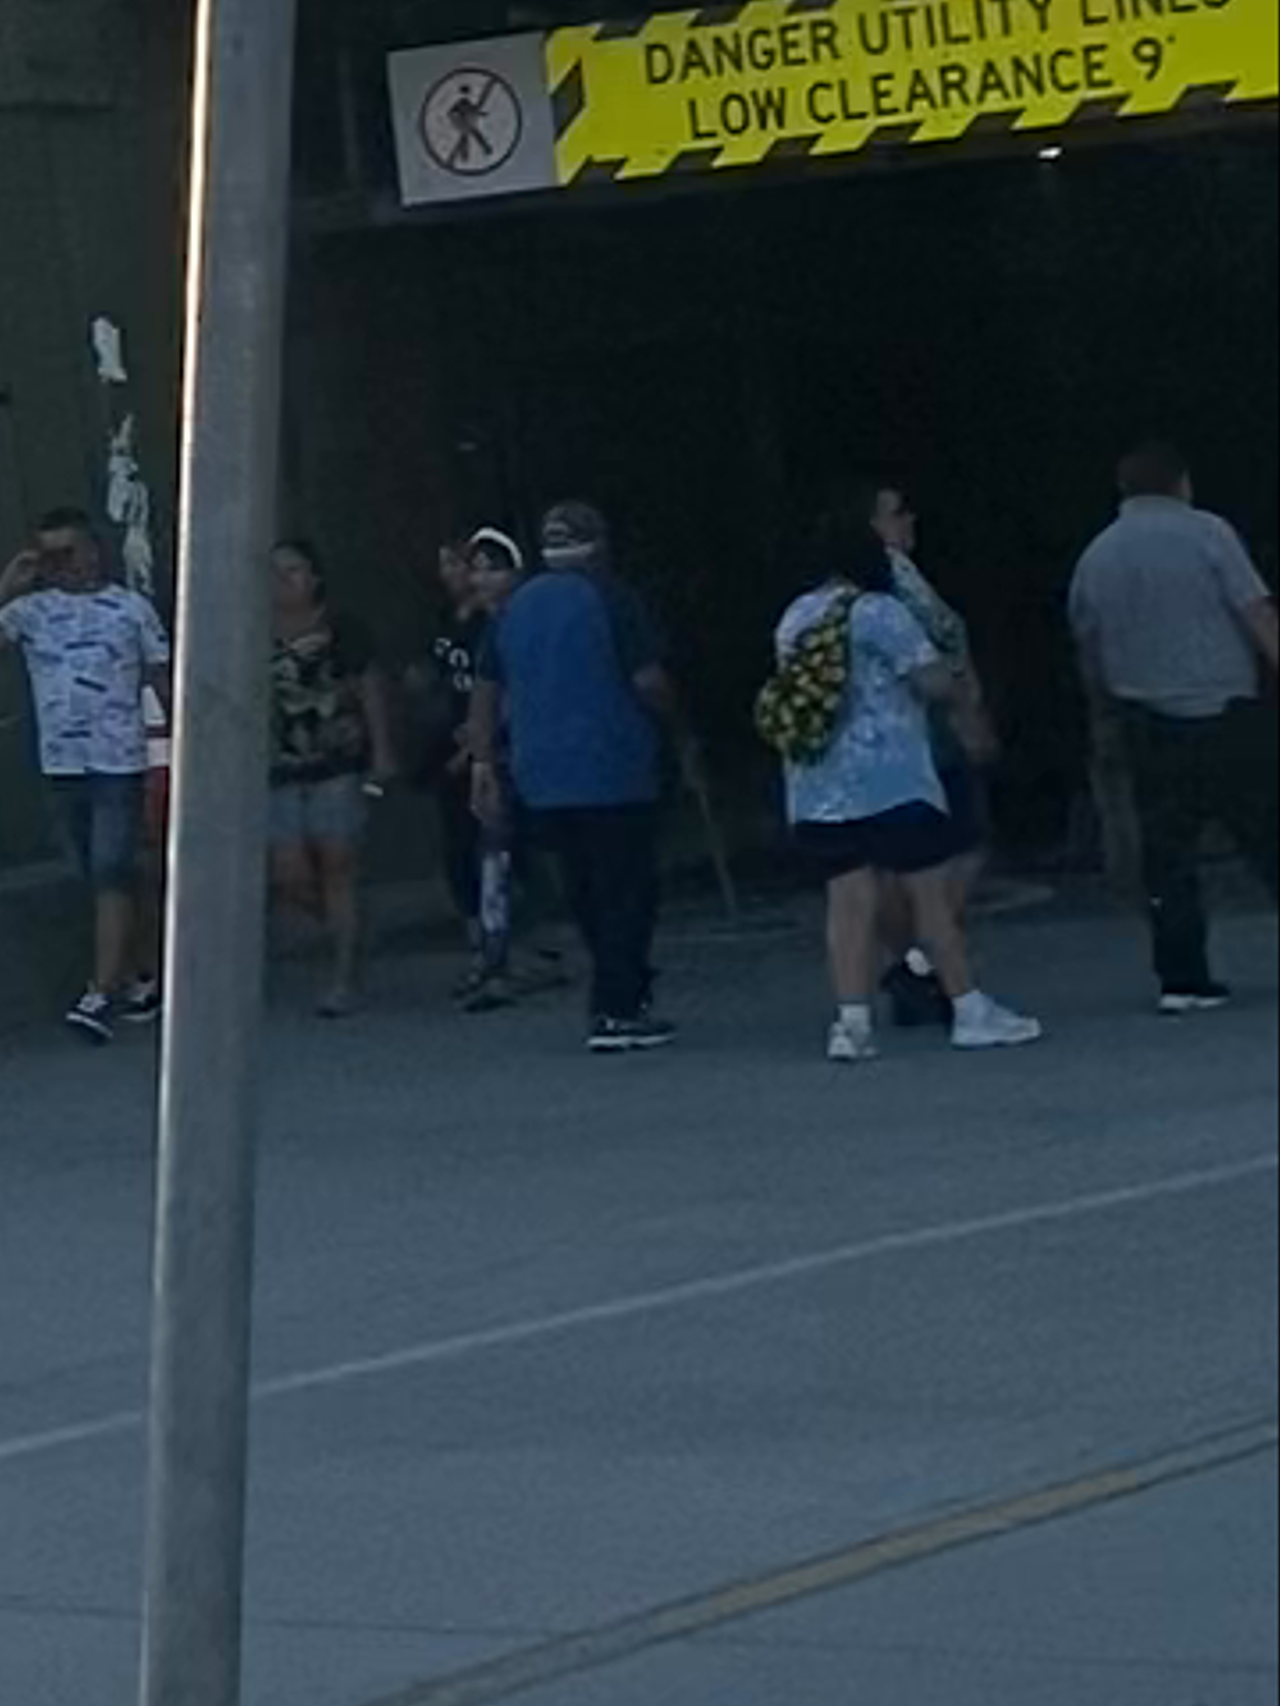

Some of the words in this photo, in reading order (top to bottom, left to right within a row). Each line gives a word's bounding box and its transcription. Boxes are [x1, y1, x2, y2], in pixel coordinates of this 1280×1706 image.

[643, 19, 841, 87] DANGER
[687, 86, 786, 140] LOW
[806, 43, 1114, 126] CLEARANCE
